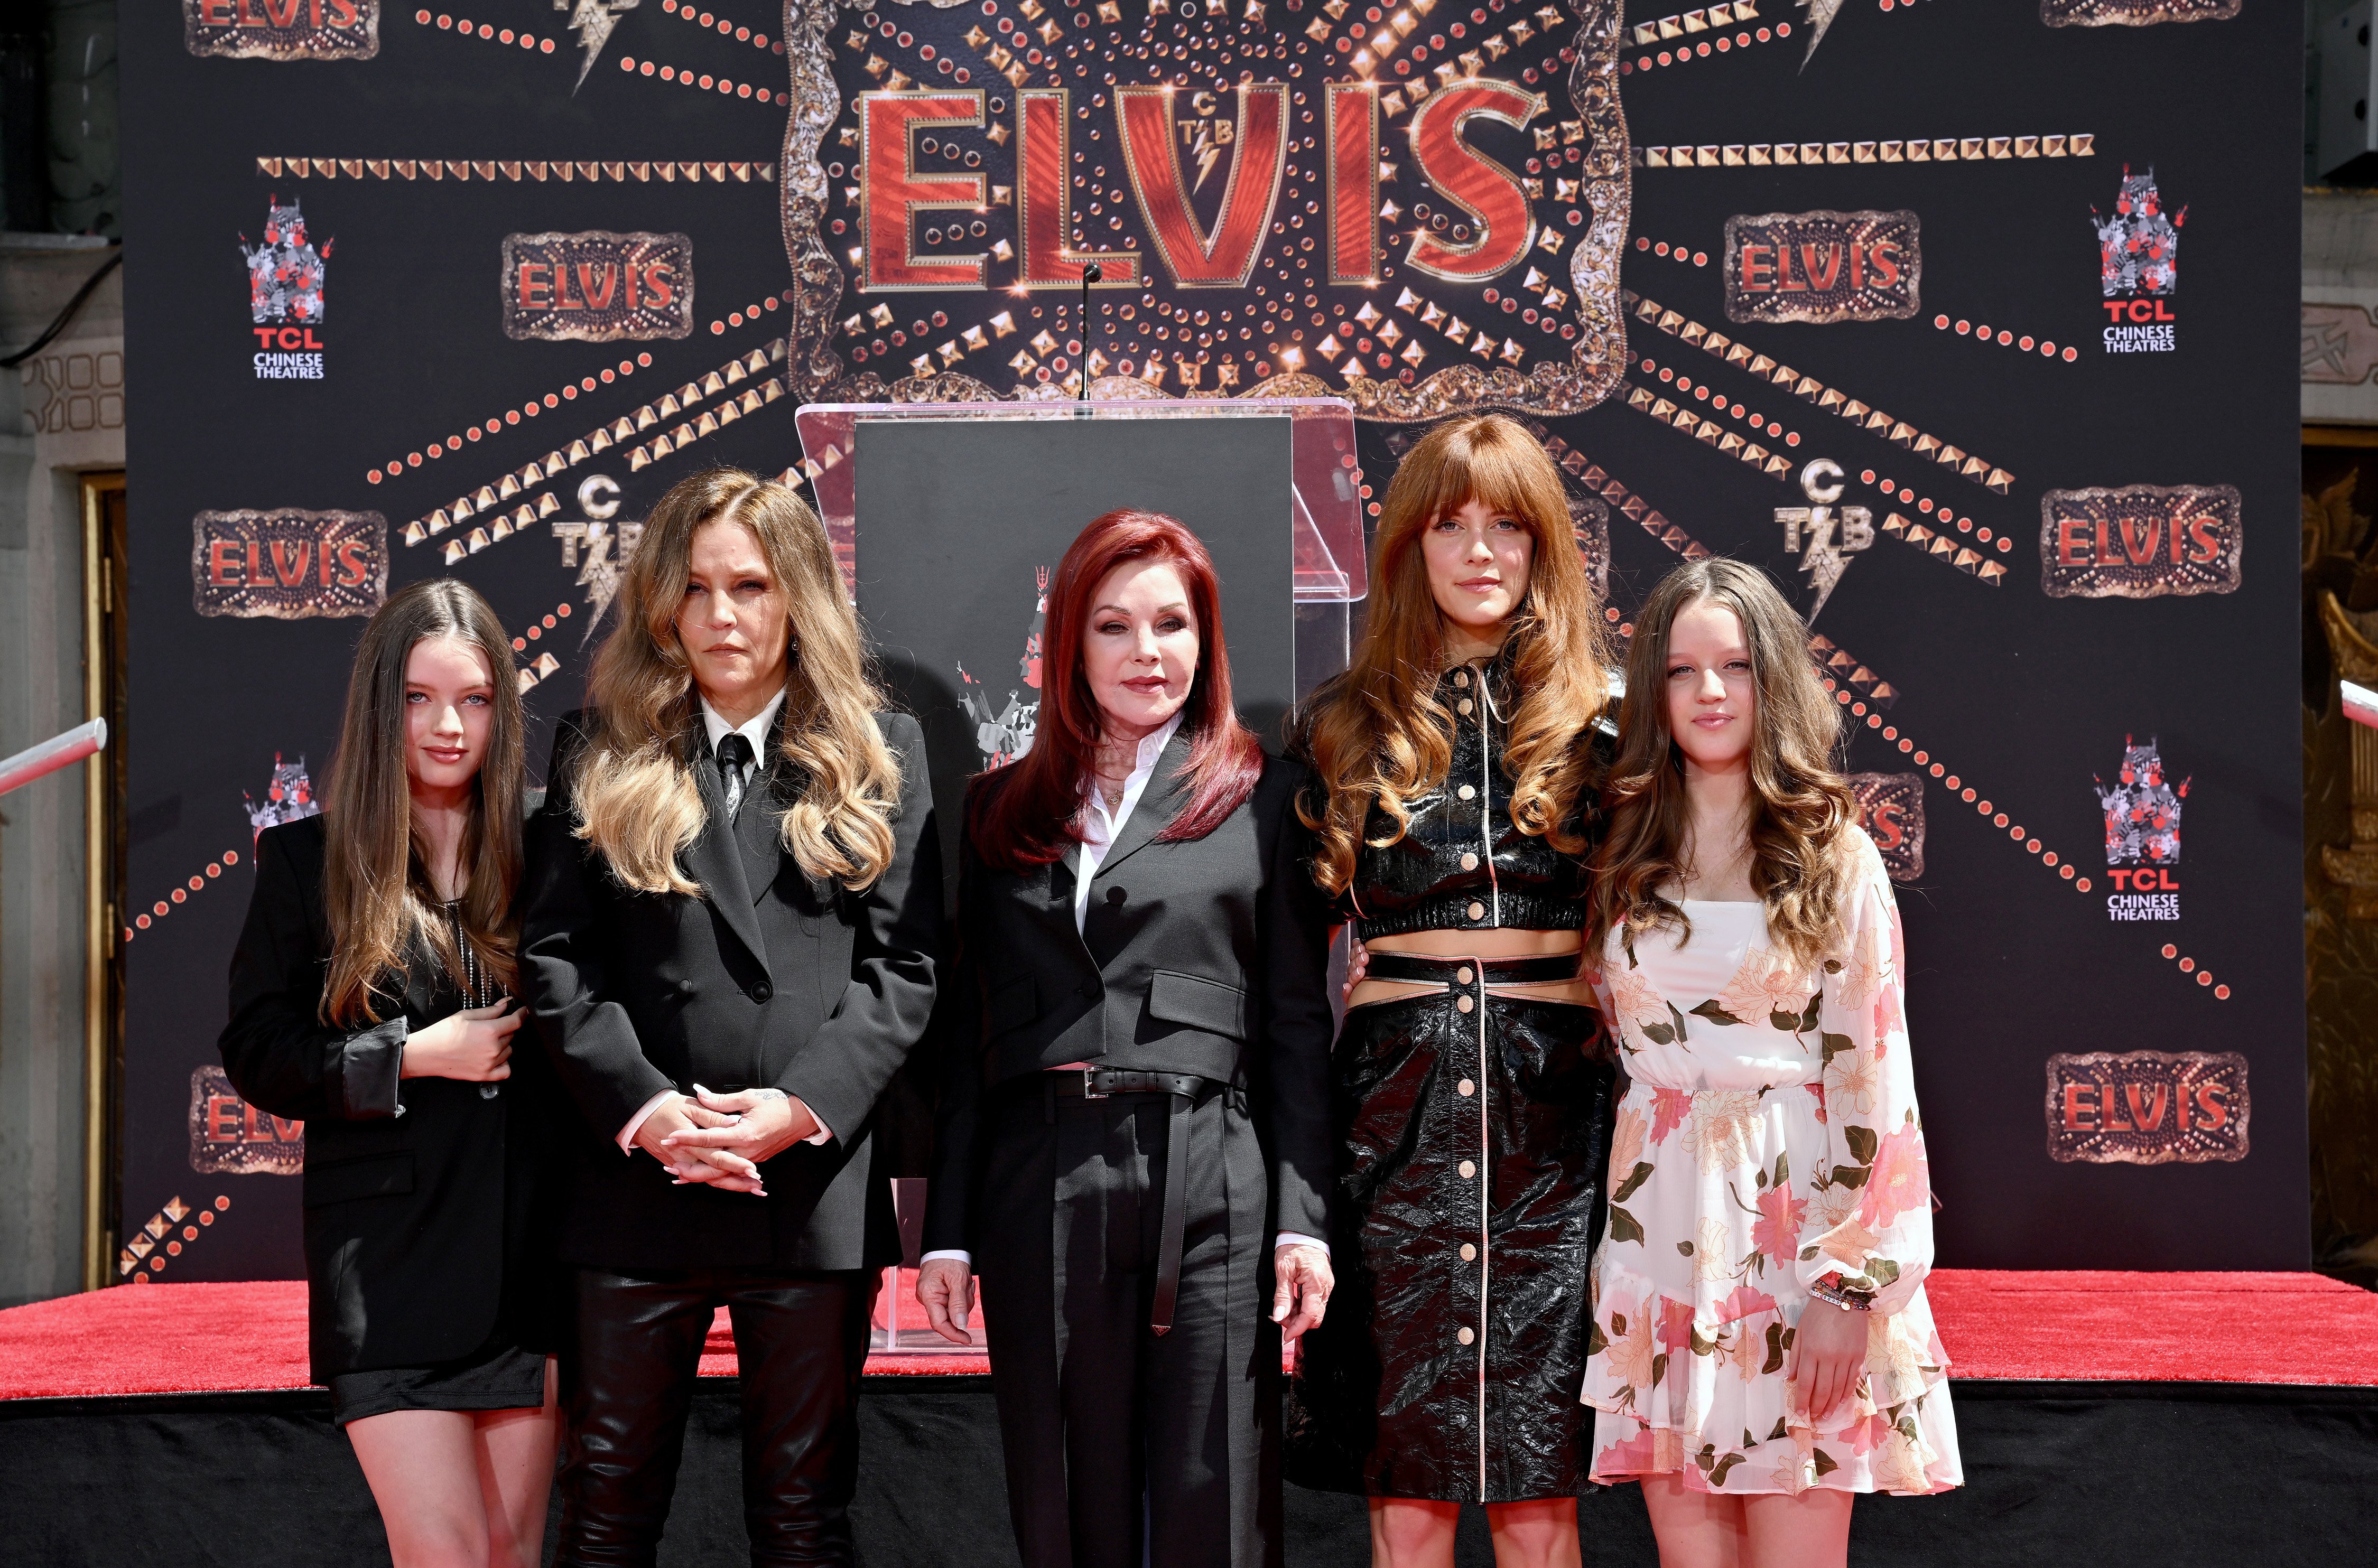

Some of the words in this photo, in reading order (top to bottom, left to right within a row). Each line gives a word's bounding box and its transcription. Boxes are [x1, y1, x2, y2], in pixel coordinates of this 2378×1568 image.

[200, 0, 359, 29] ELVIS
[860, 80, 1540, 292] ELVIS
[1741, 241, 1902, 293] ELVIS
[519, 263, 676, 310] ELVIS
[2103, 299, 2175, 322] TCL
[253, 327, 323, 350] TCL
[2103, 325, 2175, 341] CHINESE
[2103, 339, 2176, 353] THEATRES
[253, 352, 323, 367] CHINESE
[254, 366, 324, 379] THEATRES
[2058, 515, 2223, 567] ELVIS
[209, 539, 370, 588] ELVIS
[2107, 868, 2179, 891] TCL
[2107, 894, 2179, 909] CHINESE
[2107, 908, 2180, 921] THEATRES
[2064, 1082, 2230, 1132] ELVIS
